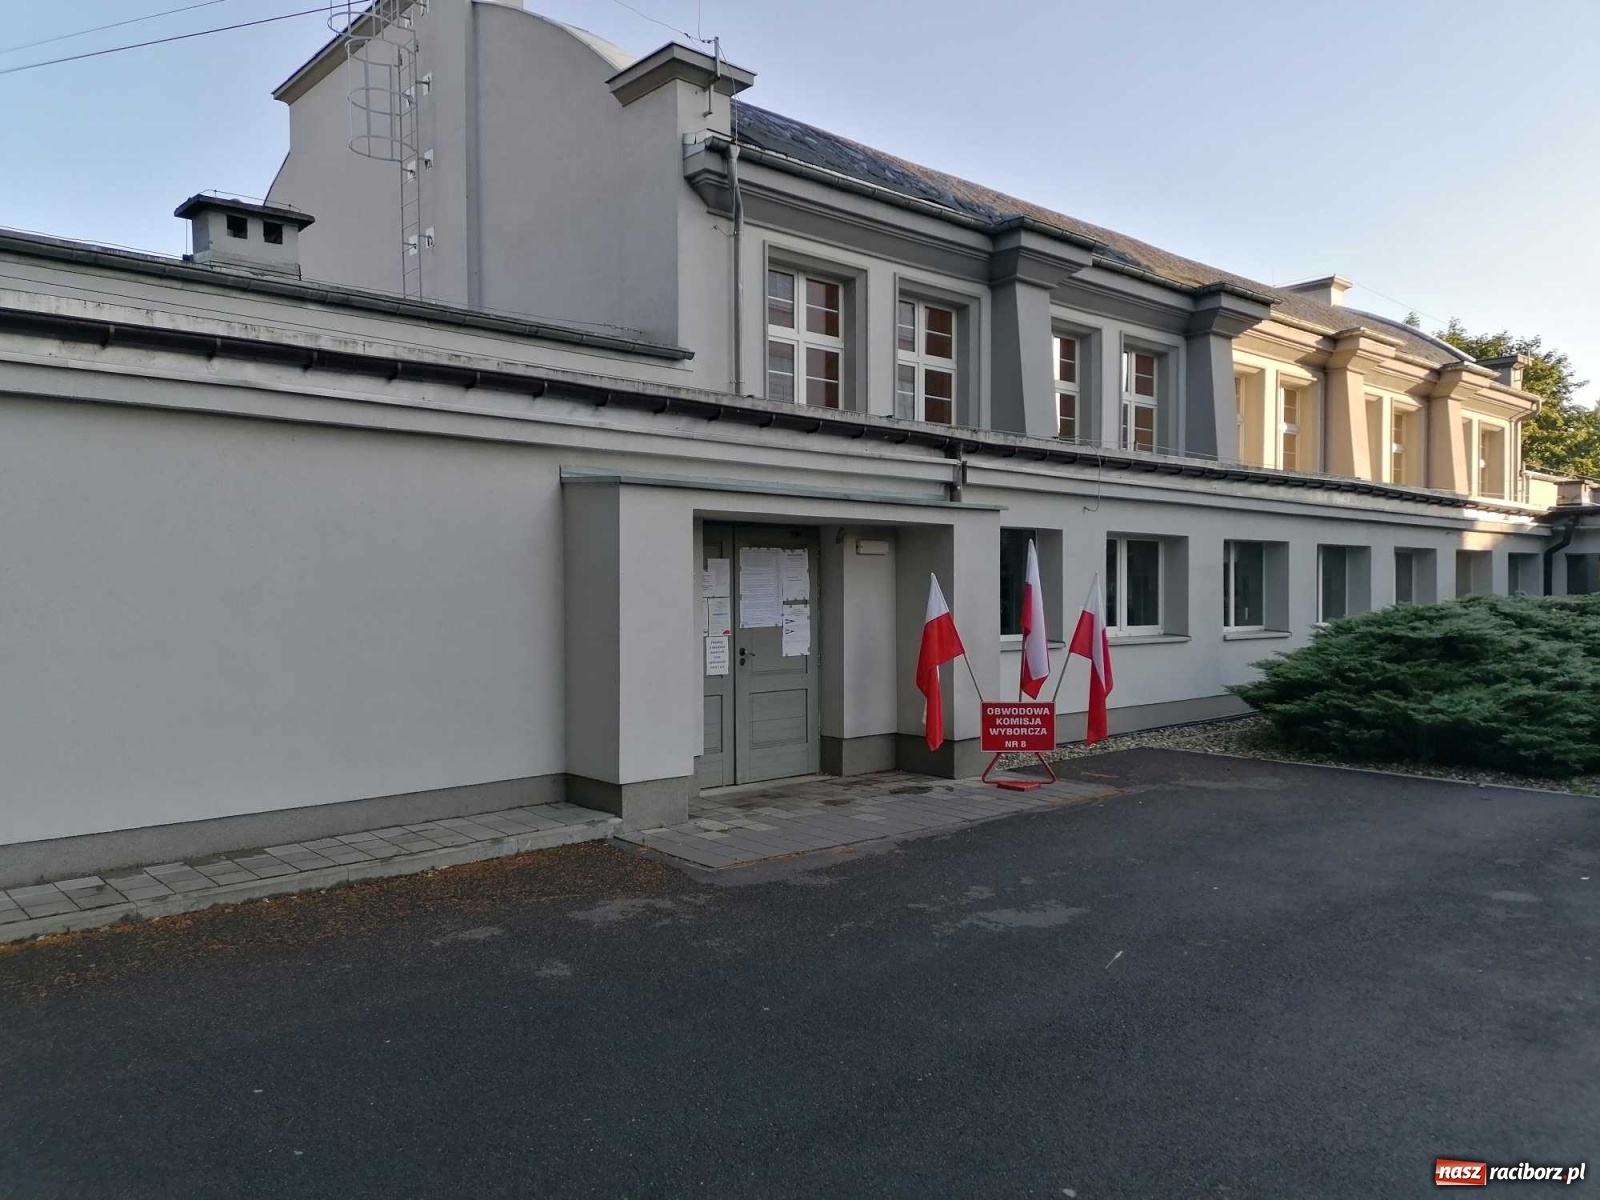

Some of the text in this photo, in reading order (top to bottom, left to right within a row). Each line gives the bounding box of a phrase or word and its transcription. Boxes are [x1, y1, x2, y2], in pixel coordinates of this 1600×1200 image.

[987, 707, 1050, 715] OBWODOWA
[996, 717, 1042, 725] KOMISJA
[989, 727, 1047, 736] WYBORCZA
[1004, 740, 1027, 748] NR 8
